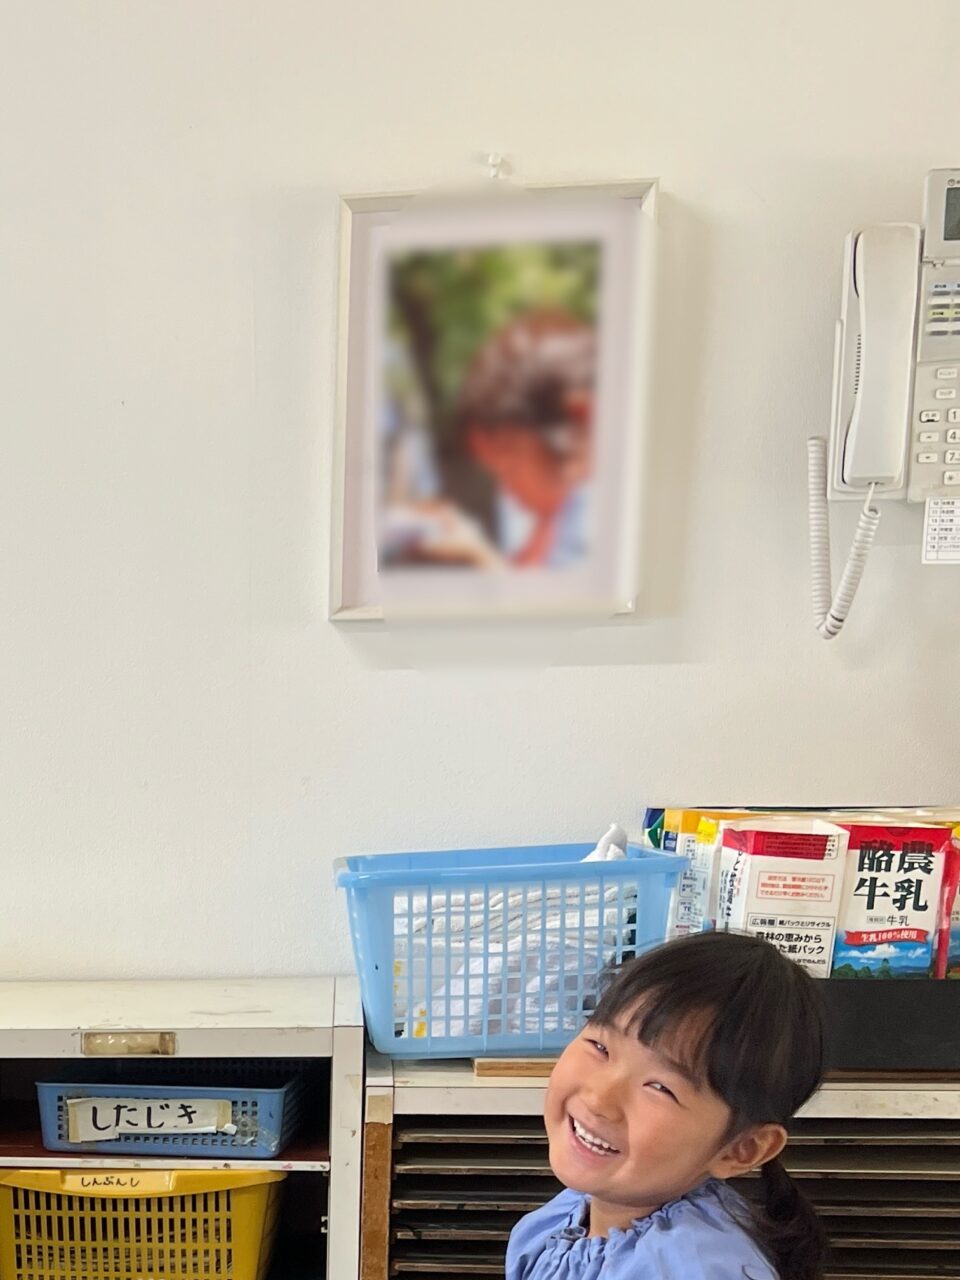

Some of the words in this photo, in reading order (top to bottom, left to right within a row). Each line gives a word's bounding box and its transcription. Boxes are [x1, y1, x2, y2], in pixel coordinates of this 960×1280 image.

[949, 431, 957, 441] 4
[857, 840, 935, 874] 酪農
[853, 877, 929, 911] 牛乳
[886, 915, 910, 927] 牛乳
[861, 930, 918, 942] 生乳100%使用
[775, 943, 825, 954] た紙パック
[91, 1103, 197, 1130] したじき
[81, 1176, 140, 1187] しんぶんし
